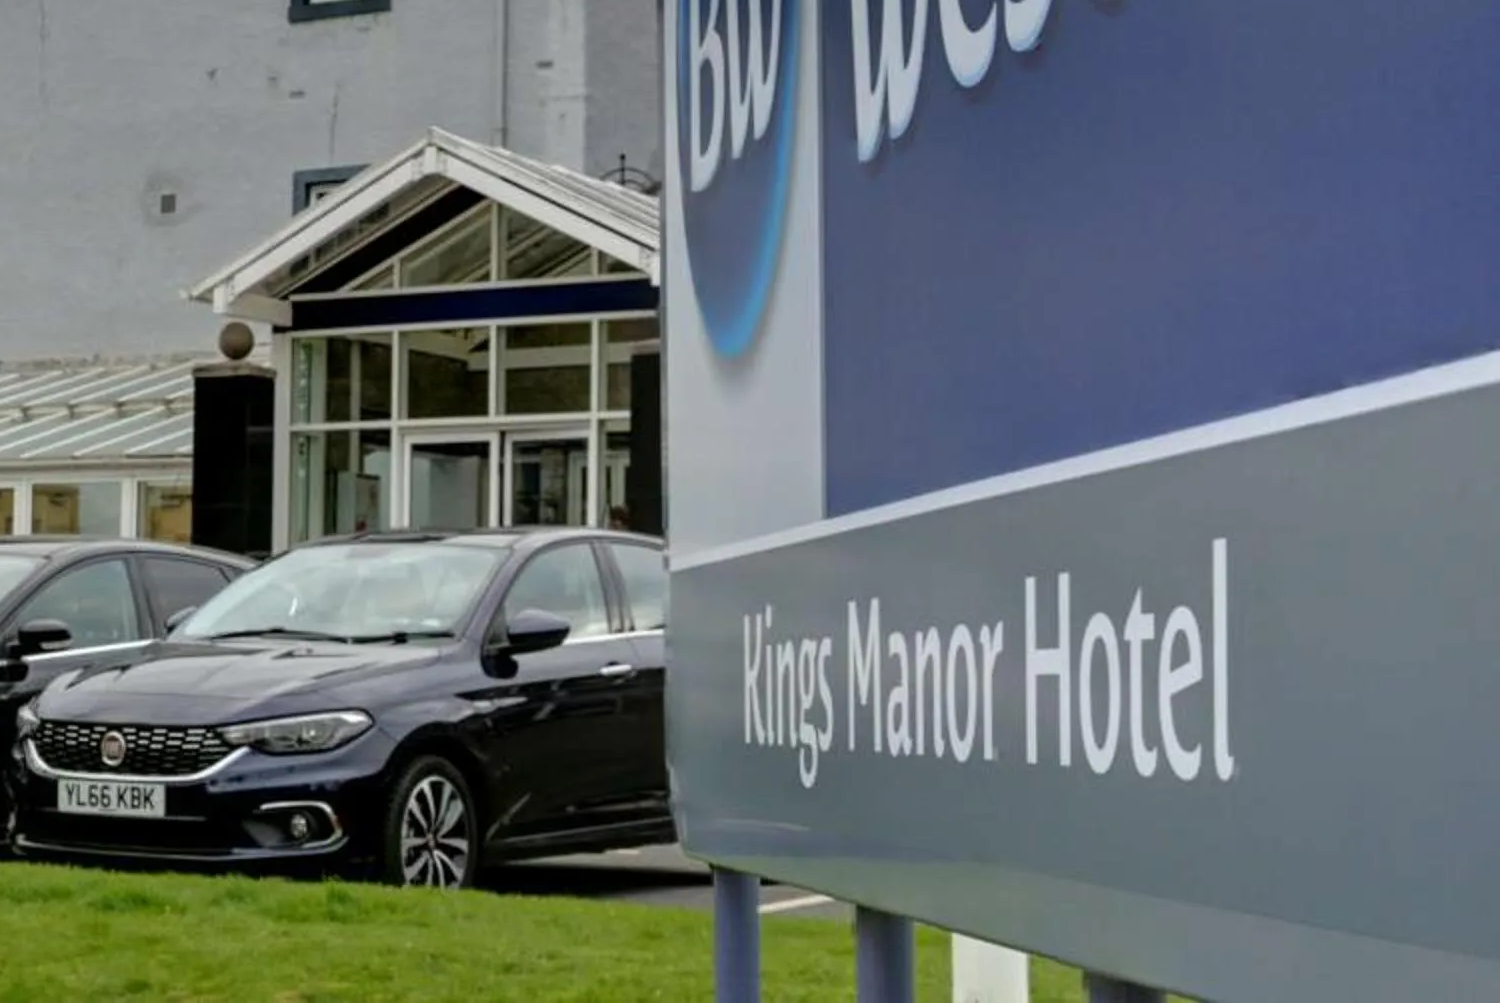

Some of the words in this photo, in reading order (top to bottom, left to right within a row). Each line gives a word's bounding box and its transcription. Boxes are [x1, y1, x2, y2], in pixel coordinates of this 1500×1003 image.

[742, 605, 834, 788] Kings
[847, 597, 1004, 763] Manor
[1024, 537, 1235, 782] Hotel
[65, 783, 112, 808] YL66
[117, 785, 156, 811] KBK
